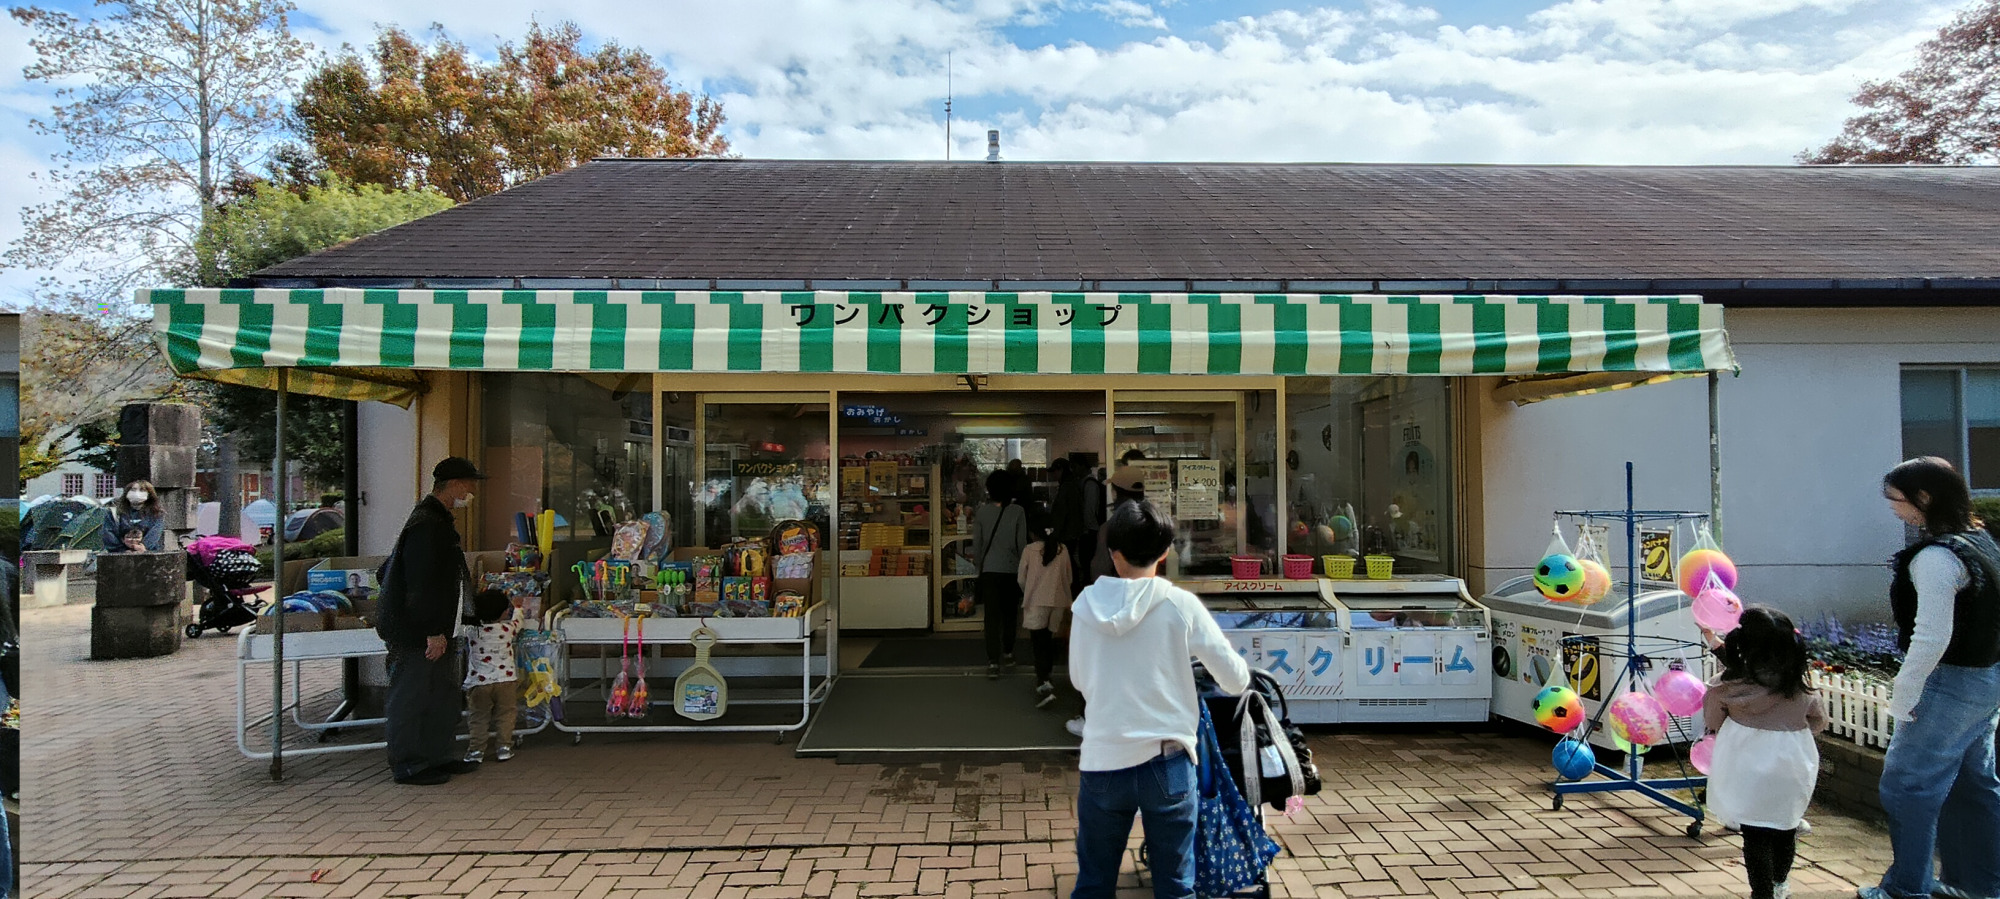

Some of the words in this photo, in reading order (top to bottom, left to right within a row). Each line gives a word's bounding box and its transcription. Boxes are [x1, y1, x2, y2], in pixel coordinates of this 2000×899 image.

[790, 303, 1123, 327] ワンパクショップ
[846, 408, 885, 417] おみやげ
[873, 416, 901, 424] おかし
[1224, 582, 1283, 592] アイスクリーム
